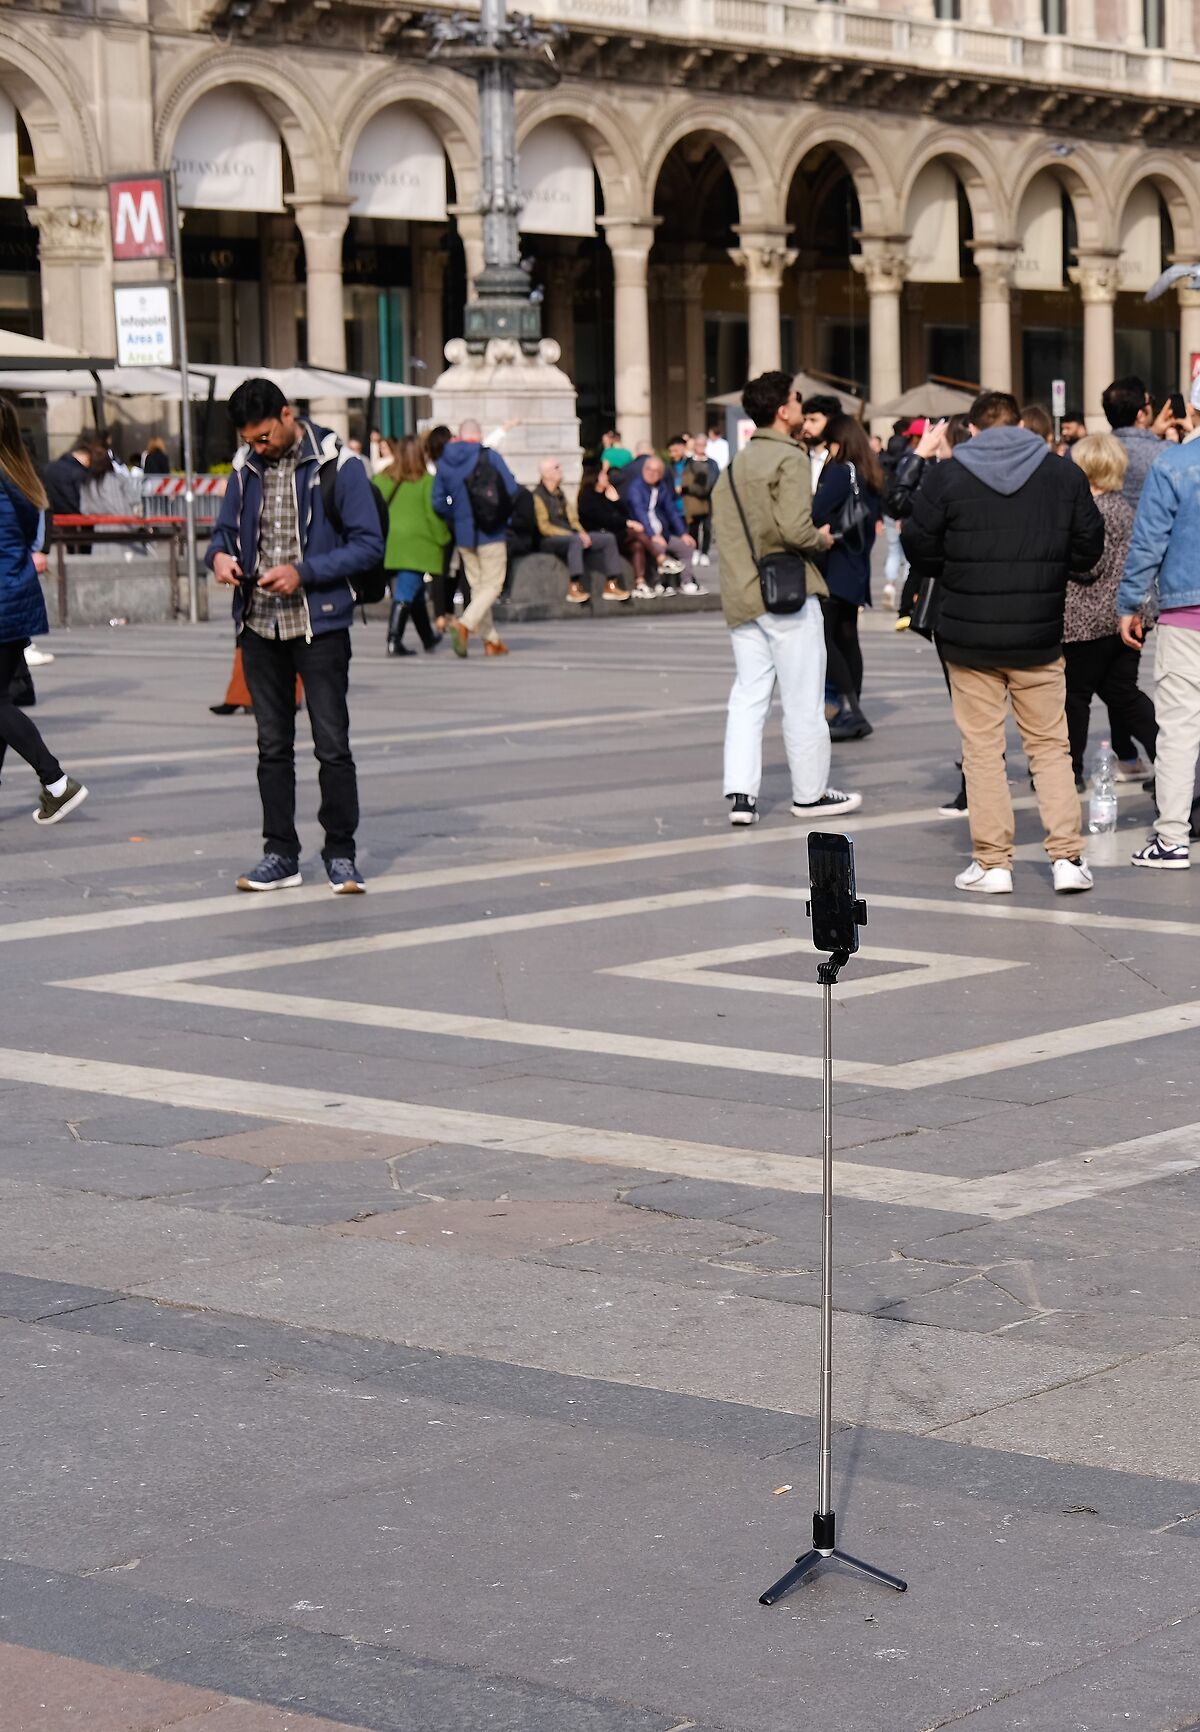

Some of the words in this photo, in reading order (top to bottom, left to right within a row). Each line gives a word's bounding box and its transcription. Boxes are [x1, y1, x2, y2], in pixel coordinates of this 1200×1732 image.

[115, 190, 164, 244] M
[126, 333, 153, 345] Area
[156, 330, 164, 344] B
